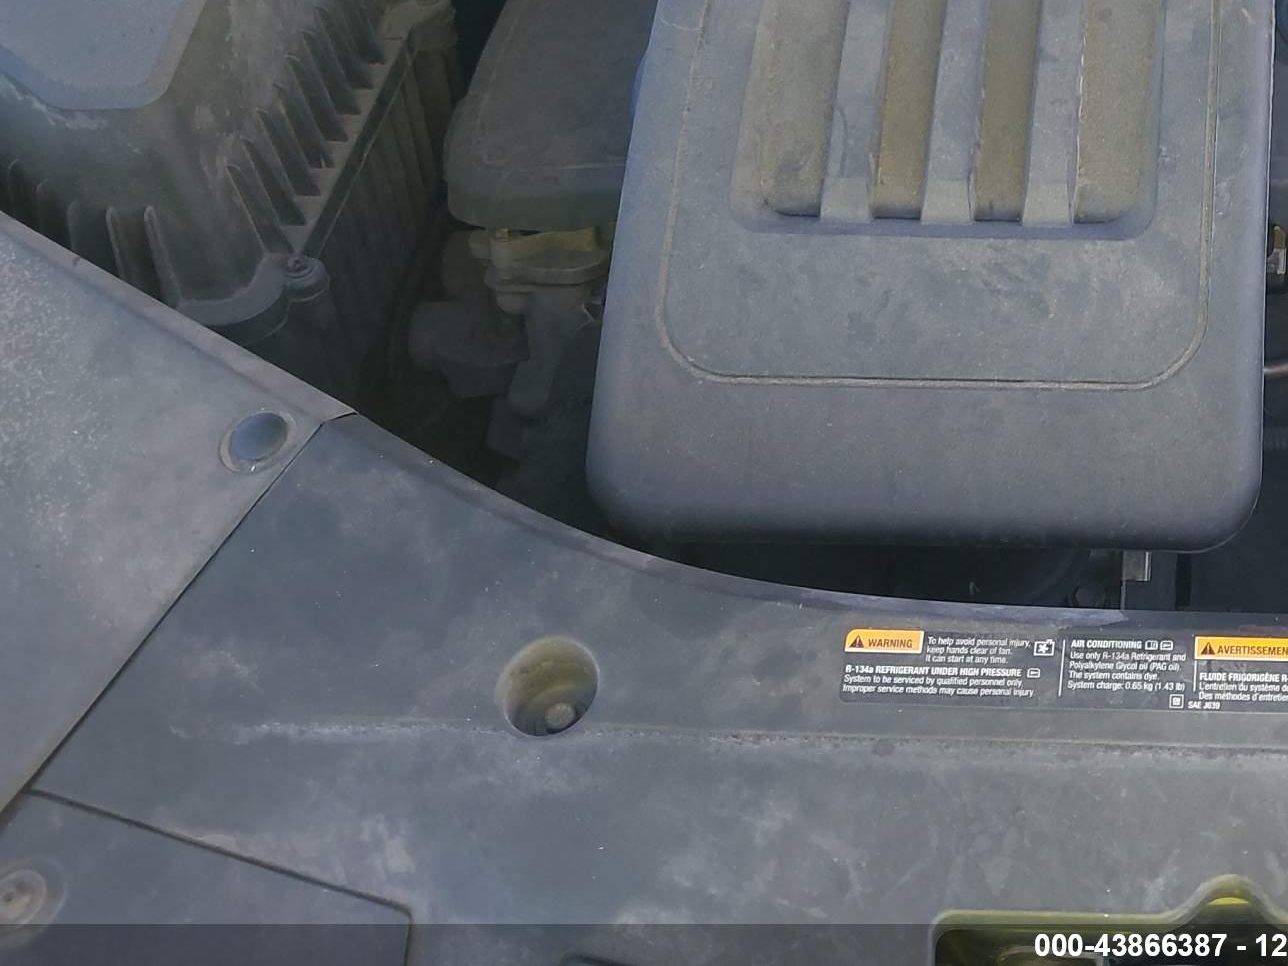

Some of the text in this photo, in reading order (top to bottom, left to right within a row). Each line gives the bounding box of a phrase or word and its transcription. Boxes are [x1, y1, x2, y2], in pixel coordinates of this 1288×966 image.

[868, 638, 913, 648] WARNING
[928, 636, 936, 644] To
[938, 636, 953, 646] help
[955, 638, 975, 646] avoid
[976, 638, 1008, 647] personal
[1070, 640, 1142, 649] AIR CONDITIONING
[927, 645, 945, 654] keep
[946, 646, 968, 654] hands
[970, 646, 988, 654] clear
[925, 654, 930, 662] It
[947, 655, 965, 663] start
[974, 657, 989, 665] any
[990, 656, 1008, 664] time.
[1070, 651, 1186, 662] Use only R-134a Refrigerant and
[845, 665, 1022, 677] R-134a REFRIGERANT UNDER HIGH PRESSURE
[1069, 661, 1114, 670] Polyalkylene
[1115, 662, 1137, 671] Glycol
[1138, 662, 1148, 670] oil
[1149, 662, 1167, 671] (PAG
[844, 674, 872, 683] System
[873, 675, 881, 683] to
[882, 675, 892, 683] be
[893, 676, 924, 684] serviced
[925, 677, 935, 685] by
[936, 677, 968, 686] qualified
[969, 678, 1005, 686] personnel
[1068, 670, 1159, 681] The system contains dye.
[1200, 672, 1227, 681] FLUIDE
[842, 684, 876, 694] Improper
[877, 685, 904, 693] service
[906, 686, 937, 694] methods
[939, 687, 956, 696] may
[956, 687, 978, 695] cause
[980, 688, 1012, 697] personal
[1067, 680, 1094, 690] System
[1096, 681, 1123, 691] charge:
[1124, 682, 1142, 690] 0.65
[1143, 682, 1153, 691] kg
[1175, 682, 1185, 691] lb)
[1238, 683, 1248, 691] du
[1198, 691, 1213, 700] Des
[1188, 701, 1201, 709] SAE
